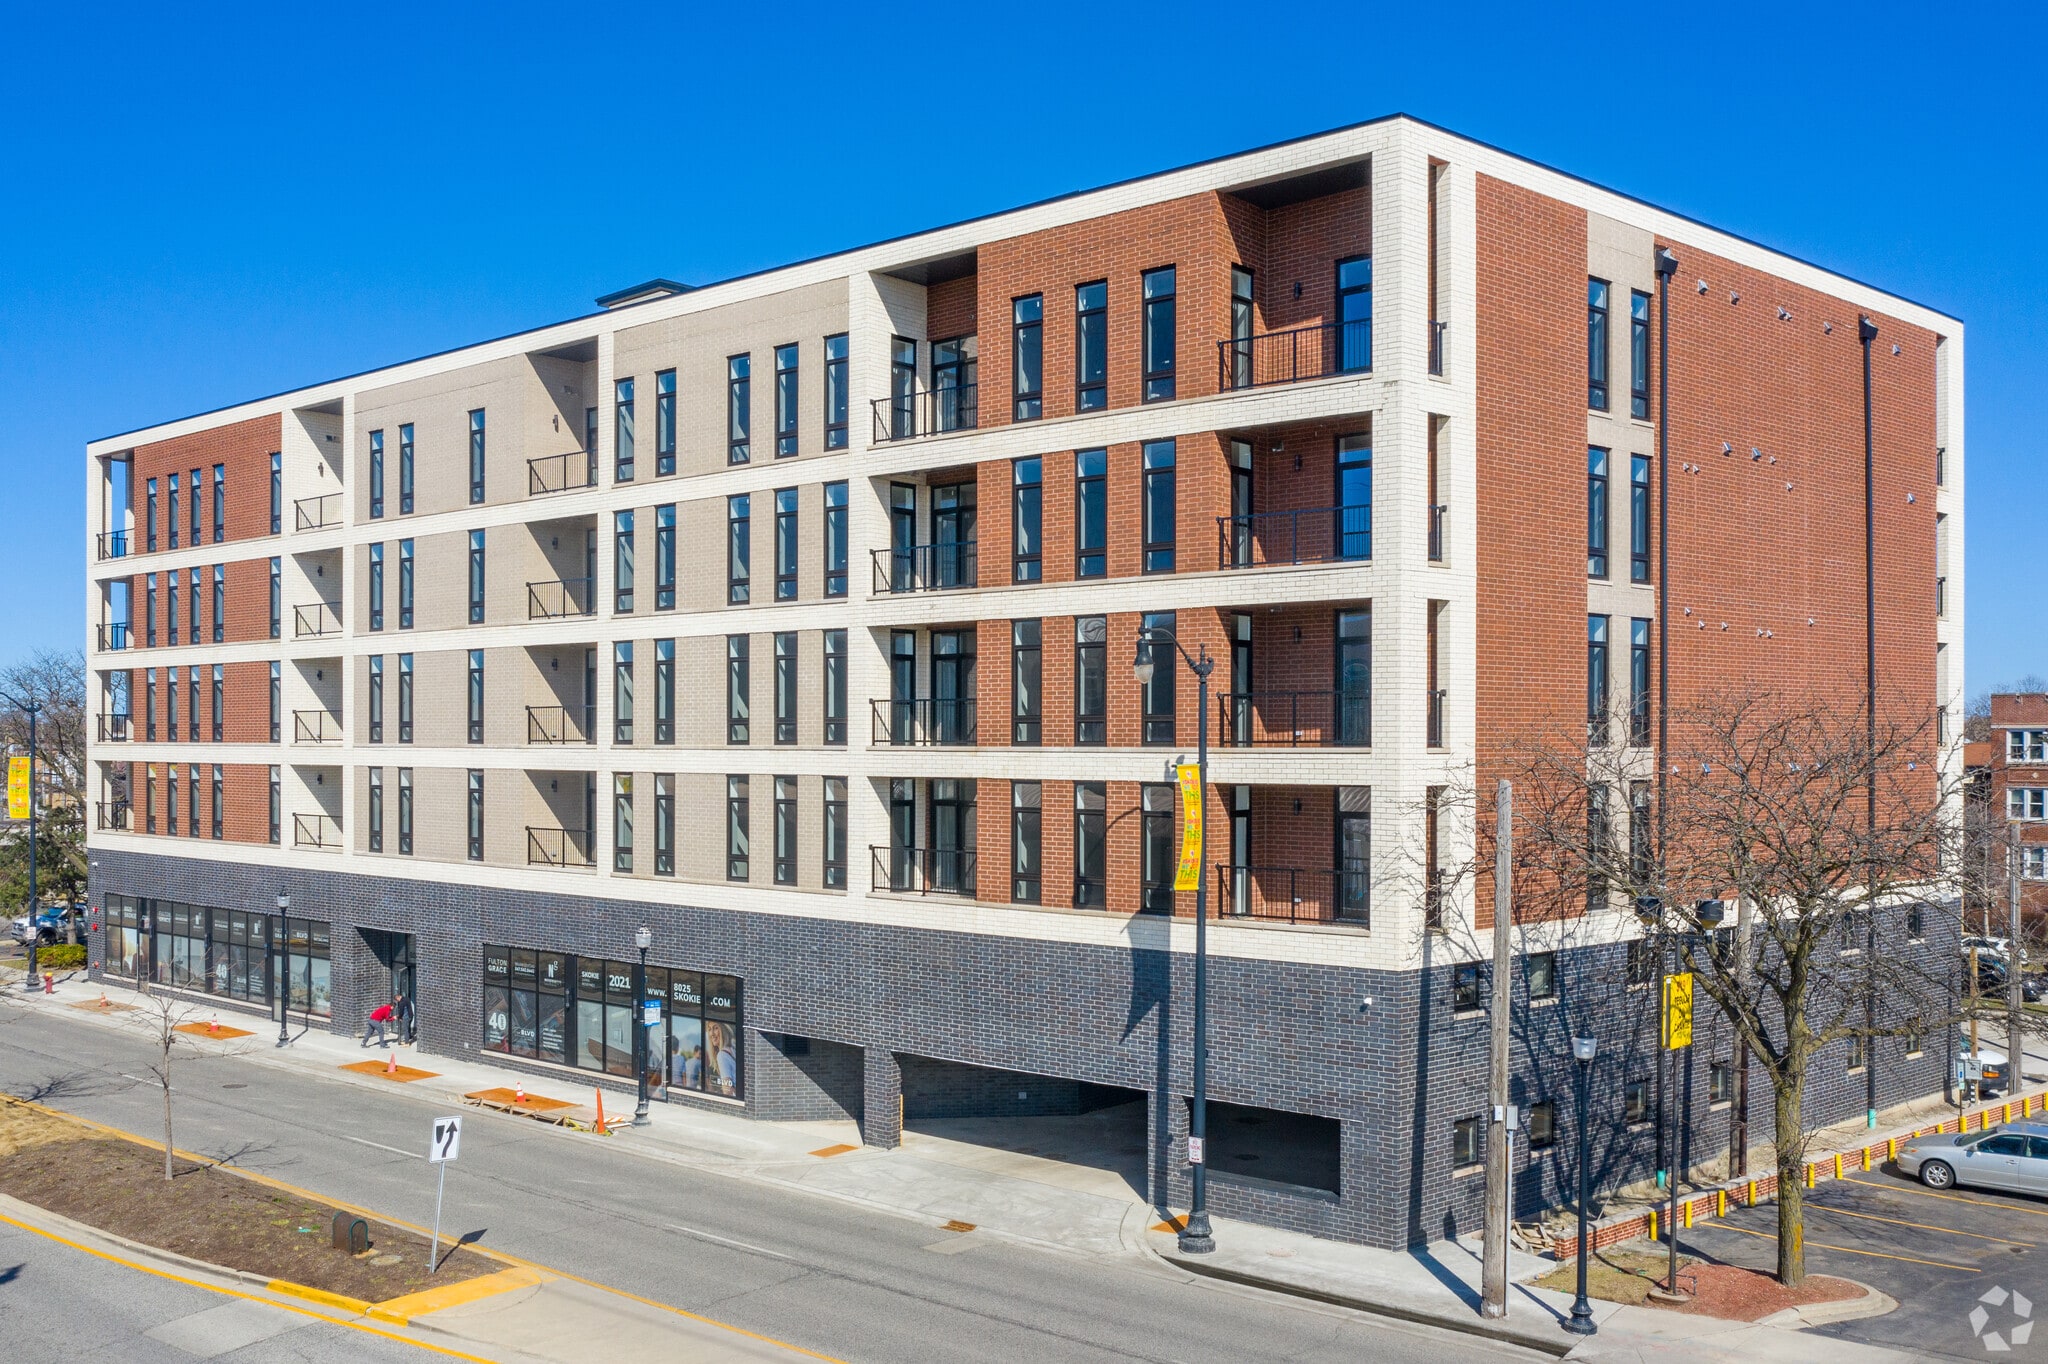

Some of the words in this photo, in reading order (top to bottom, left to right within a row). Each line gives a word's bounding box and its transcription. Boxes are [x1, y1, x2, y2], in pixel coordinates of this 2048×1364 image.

[1180, 869, 1197, 879] THIS
[488, 957, 508, 966] FULTON
[488, 964, 507, 974] GRACE
[582, 970, 600, 980] SKOKIE
[609, 974, 631, 989] 2021
[674, 983, 691, 993] 8025
[674, 992, 701, 1004] SKOKIE
[710, 997, 731, 1008] .COM
[489, 1012, 507, 1030] 40
[521, 1029, 535, 1038] BLVD
[717, 1078, 733, 1087] BLVD
